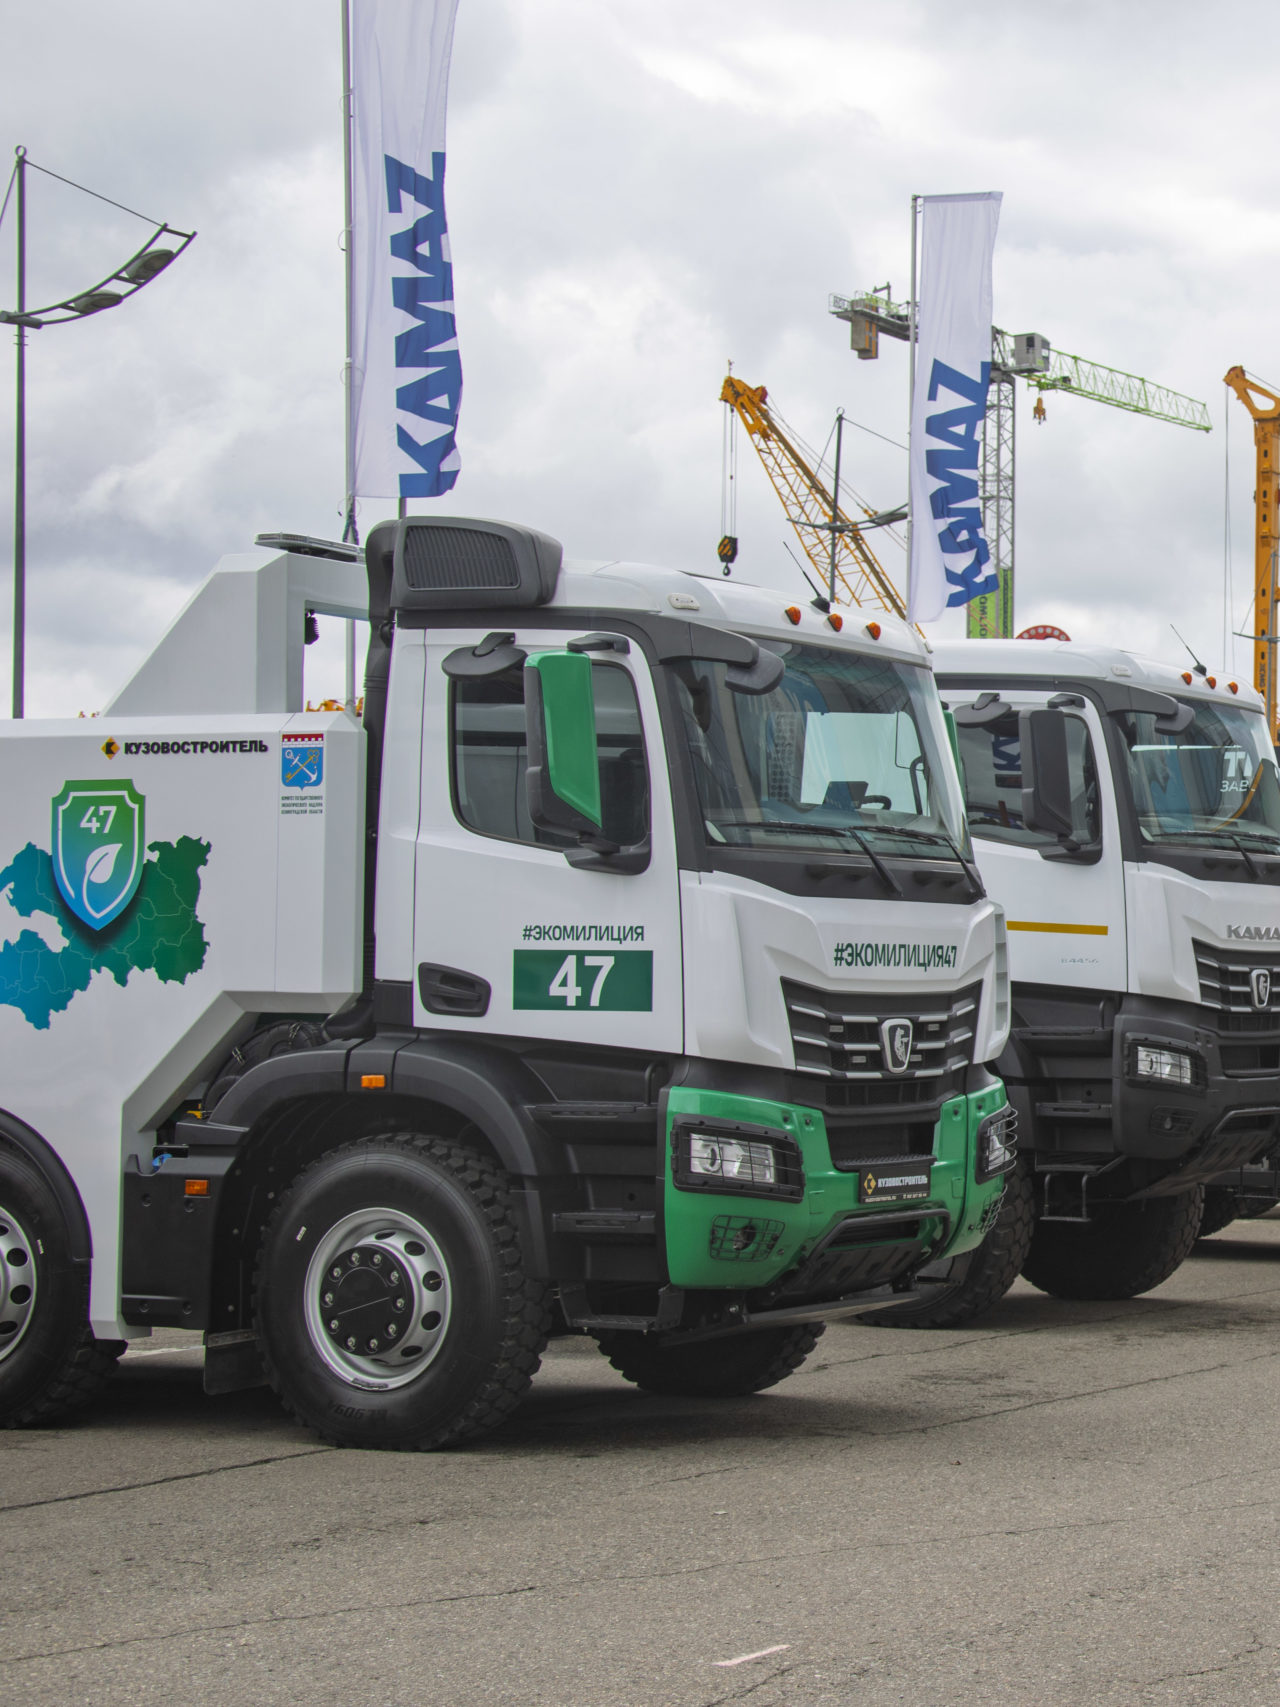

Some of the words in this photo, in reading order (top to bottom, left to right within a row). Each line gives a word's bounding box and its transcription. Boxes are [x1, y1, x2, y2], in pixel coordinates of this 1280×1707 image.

[384, 151, 463, 498] KAMAZ
[925, 358, 1000, 608] KAMAZ
[124, 740, 269, 754] КУЗОВОСТРОИТЕЛЬ
[80, 805, 117, 834] 47
[522, 925, 645, 944] #ЭКОМИЛИЦИЯ
[834, 942, 957, 972] #ЭКОМИЛИЦИЯ47
[549, 954, 615, 1007] 47
